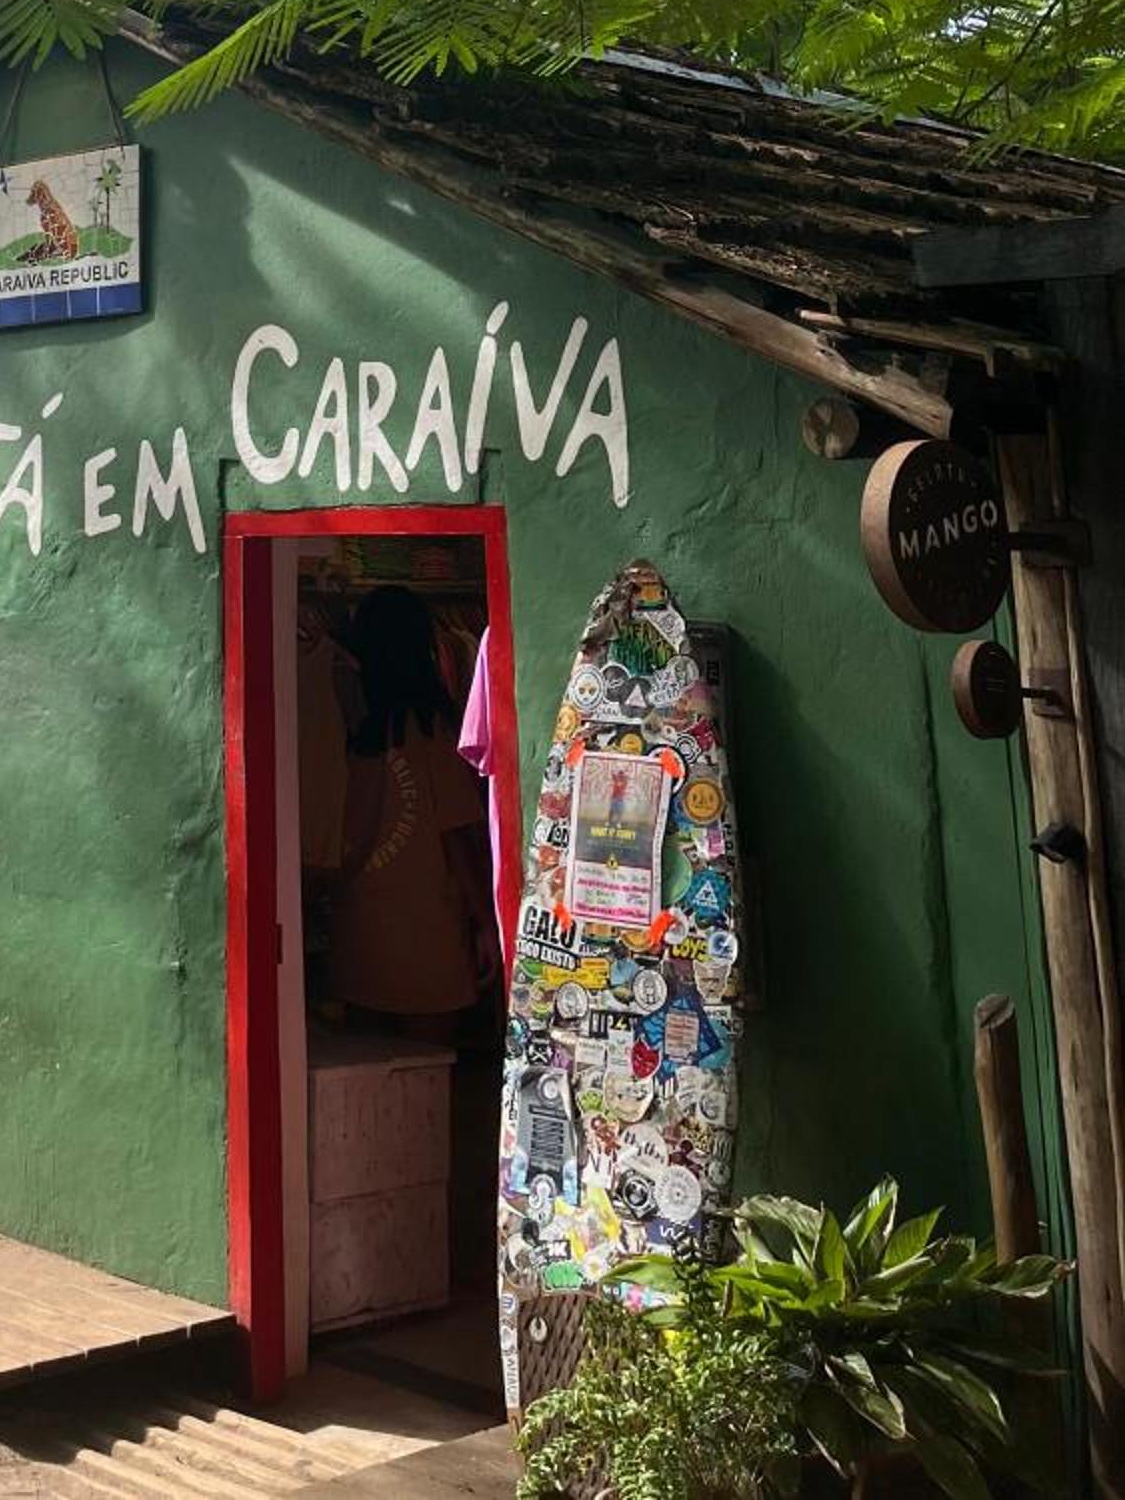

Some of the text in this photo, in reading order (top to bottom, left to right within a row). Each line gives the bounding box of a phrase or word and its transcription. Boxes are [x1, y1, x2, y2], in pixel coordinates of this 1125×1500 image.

[83, 426, 207, 555] EM
[231, 300, 629, 509] CARAÍVA
[898, 499, 999, 560] MANGO
